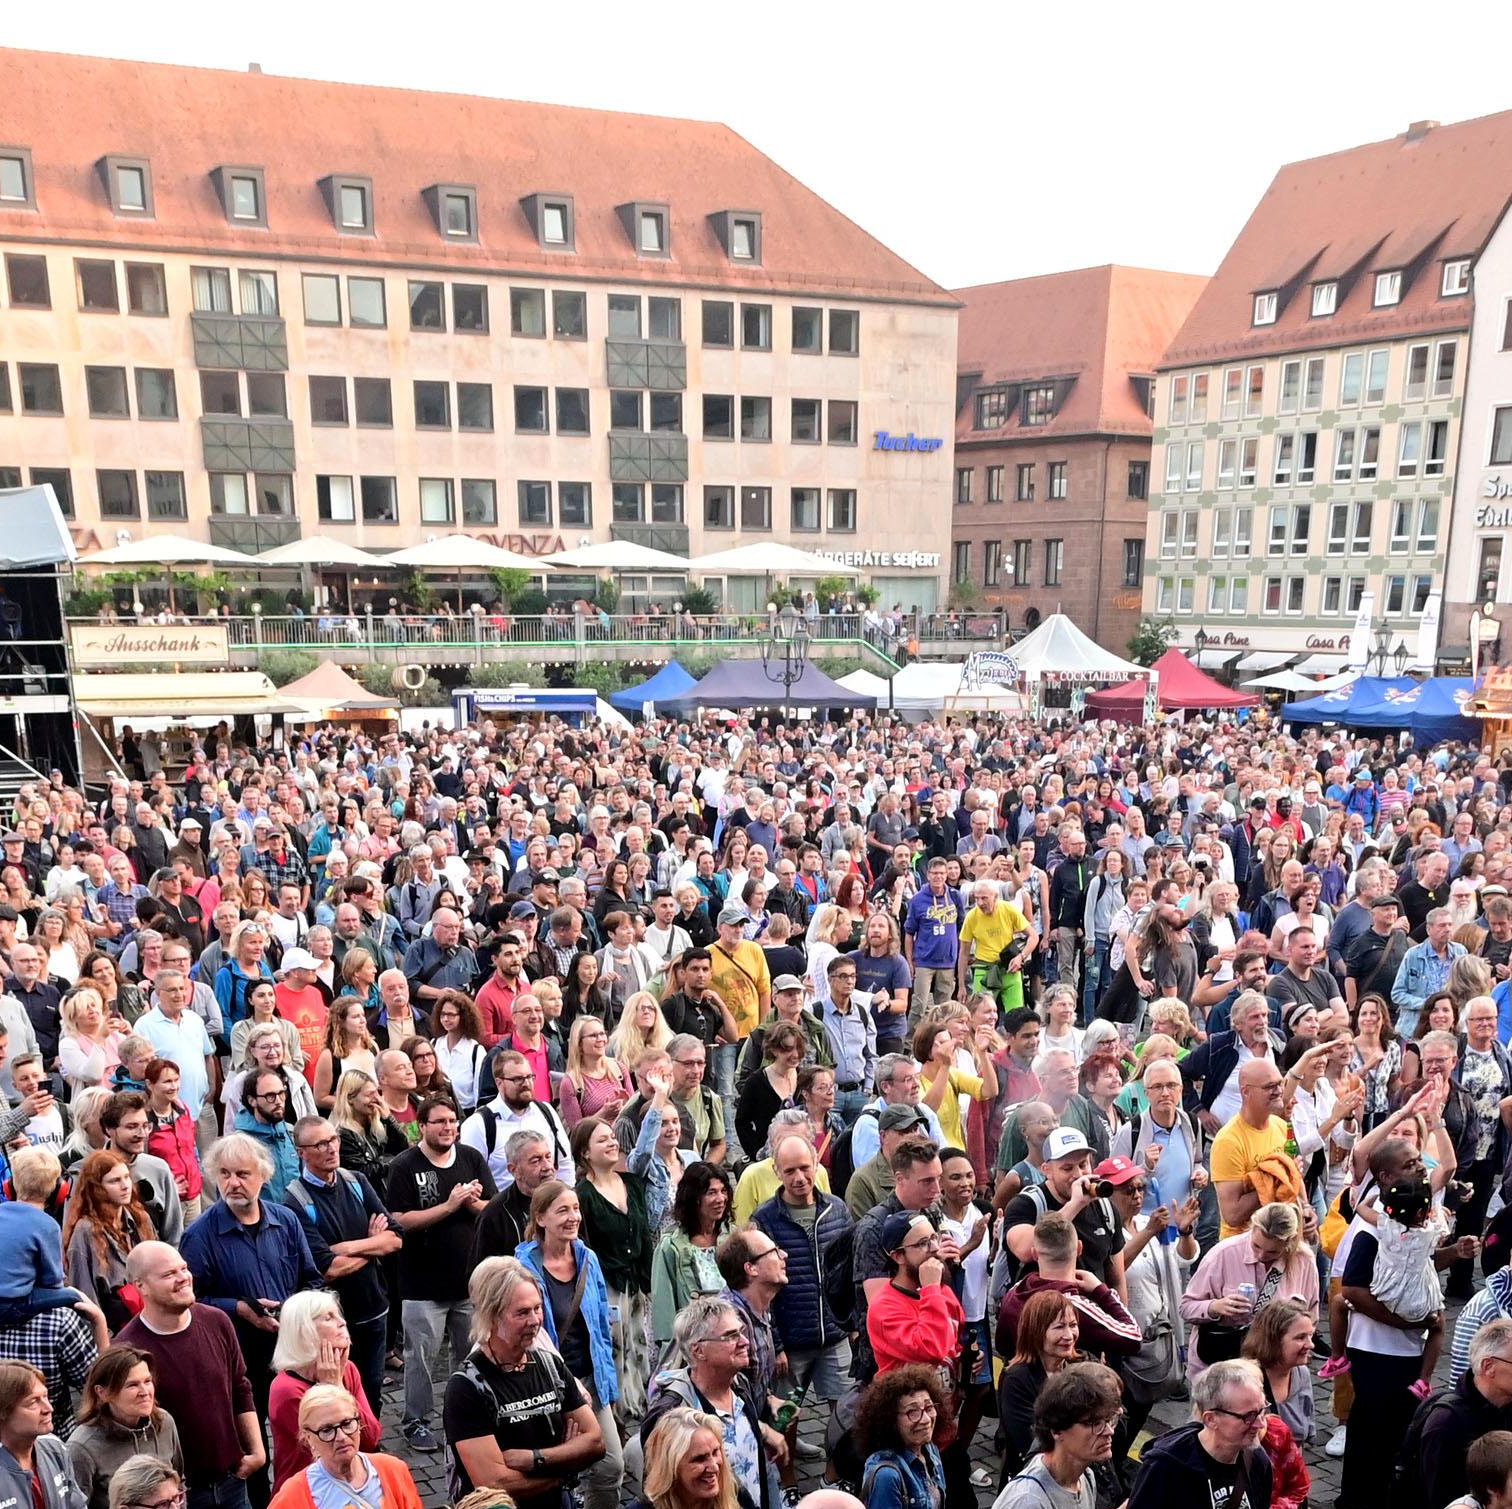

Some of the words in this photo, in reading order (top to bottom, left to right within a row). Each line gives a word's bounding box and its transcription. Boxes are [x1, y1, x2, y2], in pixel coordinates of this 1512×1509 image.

[872, 431, 944, 452] Tucher
[104, 634, 201, 653] Ausschank
[1305, 634, 1334, 649] Casa
[0, 1497, 17, 1509] JAKO
